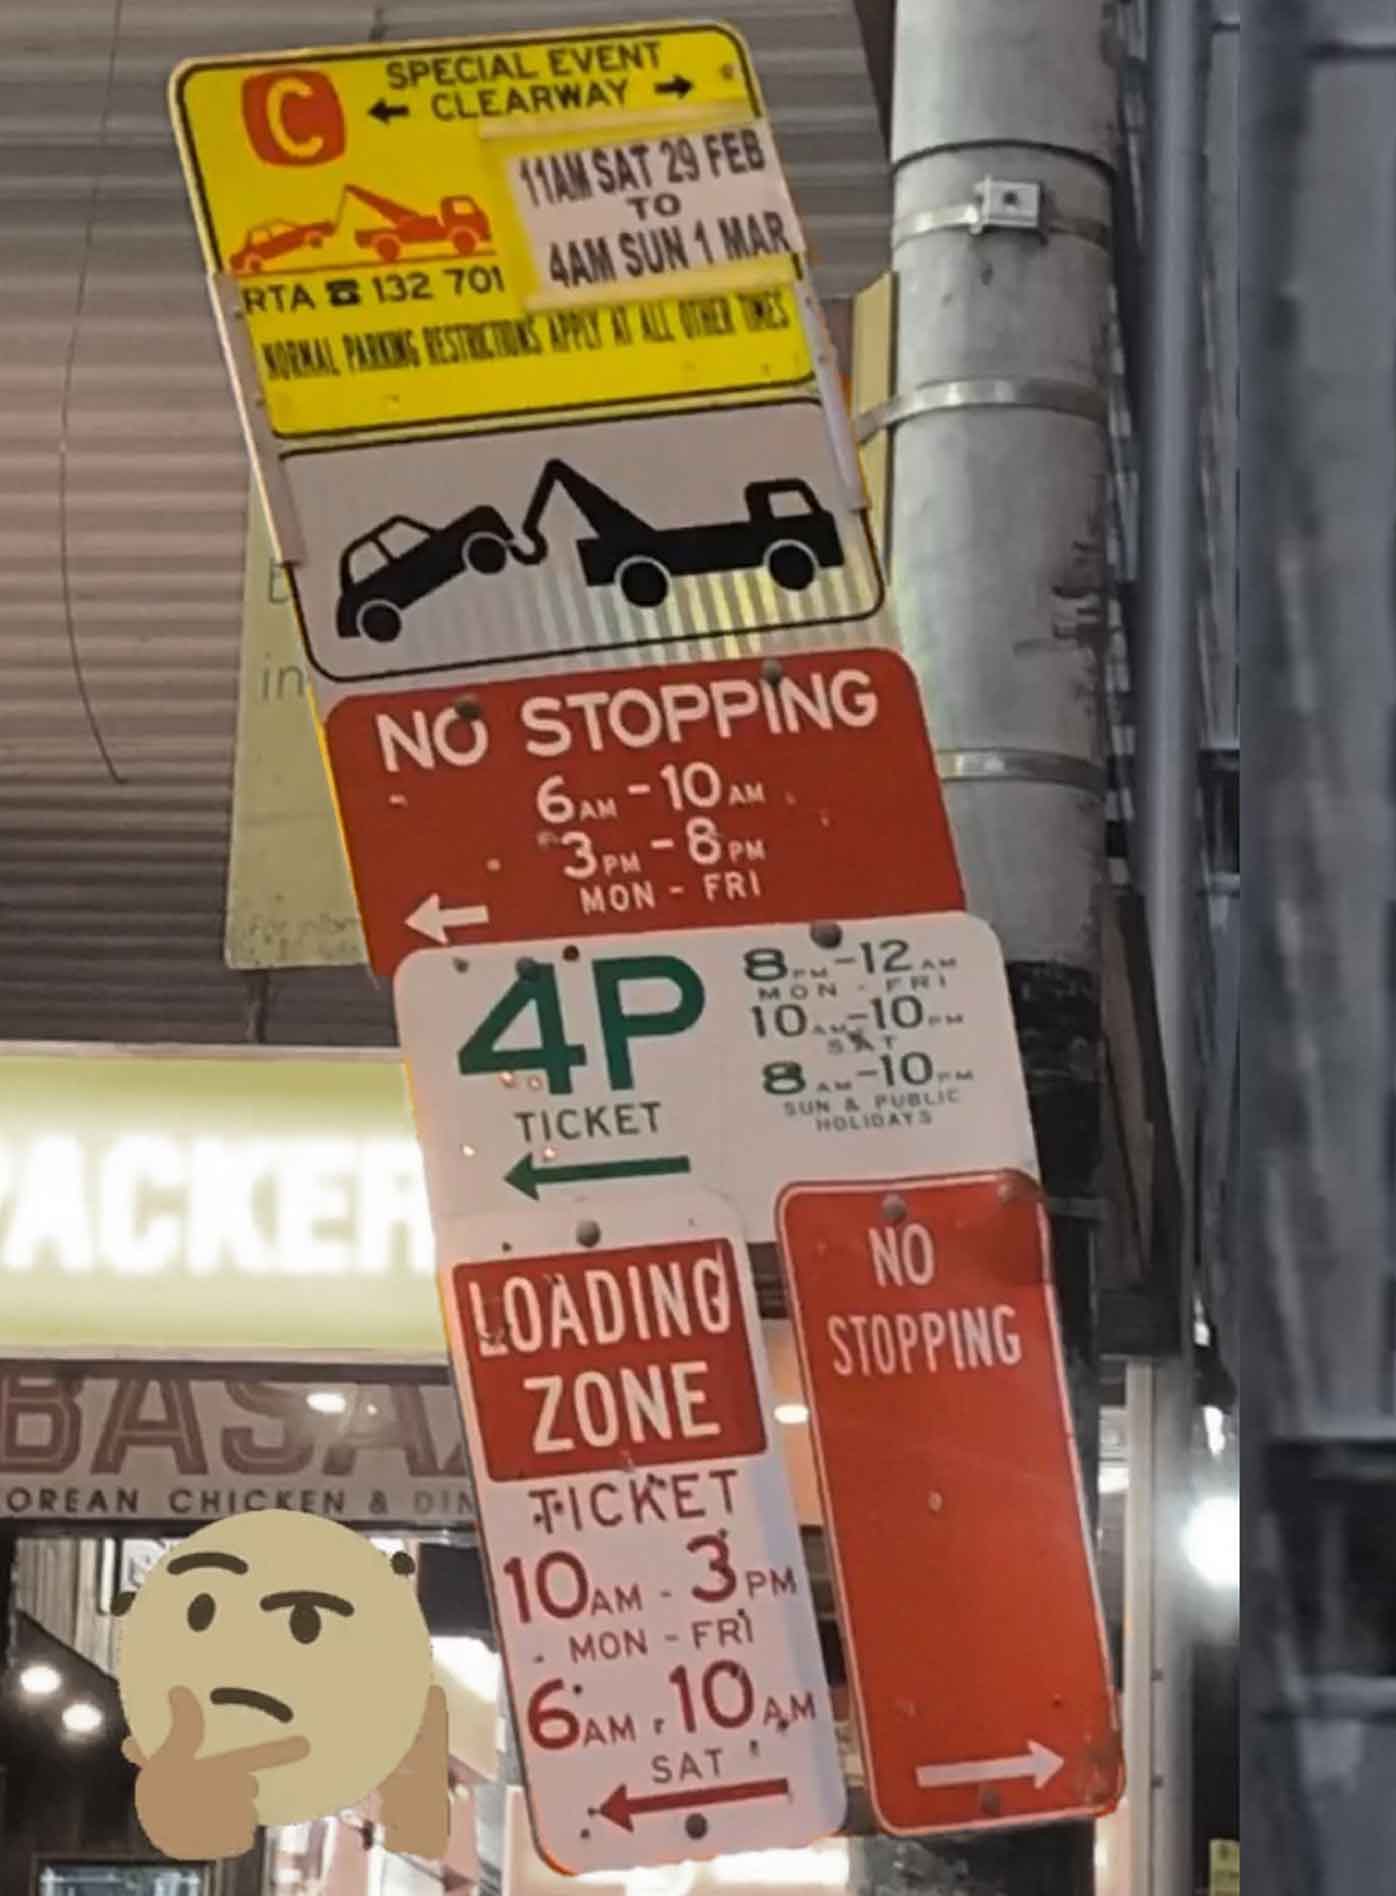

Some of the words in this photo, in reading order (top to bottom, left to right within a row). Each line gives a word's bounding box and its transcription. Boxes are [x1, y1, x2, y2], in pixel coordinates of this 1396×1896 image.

[386, 53, 536, 91] SPECIAL
[548, 41, 662, 78] EVENT
[431, 79, 631, 122] CLEARWAY
[519, 151, 592, 206] 11AM
[591, 144, 652, 193] SAT
[659, 137, 700, 183] 29
[703, 129, 765, 177] FEB
[627, 193, 681, 221] TO
[551, 237, 617, 288] 4AM
[619, 226, 689, 277] SUN
[694, 220, 714, 264] 1
[718, 211, 793, 261] MAR
[242, 284, 316, 315] RTA
[372, 272, 434, 304] 132
[443, 265, 504, 295] 701
[261, 337, 340, 381] NORMAL
[342, 328, 421, 373] PARKING
[423, 316, 541, 366] RESTRICTIONS
[547, 308, 603, 353] APPLY
[610, 304, 632, 347] AT
[639, 299, 675, 342] ALL
[678, 295, 735, 339] OTHER
[736, 289, 790, 332] TIMES
[376, 700, 488, 773] NO
[521, 669, 879, 757] STOPPING
[579, 881, 656, 915] MON
[703, 869, 761, 901] FRI
[757, 983, 838, 1000] MON
[886, 976, 947, 991] FRI
[458, 952, 706, 1095] 4P
[514, 1101, 662, 1143] TICKET
[784, 1099, 830, 1117] SUN
[844, 1097, 860, 1113] &
[875, 1089, 961, 1110] PUBLIC
[816, 1109, 932, 1133] HOLIDAYS
[0, 1132, 436, 1276] ACKER
[868, 1221, 935, 1288] NO
[466, 1255, 732, 1357] LOADING
[827, 1304, 1022, 1377] STOPPING
[0, 1378, 466, 1476] BASA
[523, 1362, 722, 1454] ZONE
[170, 1488, 344, 1514] CHICKEN
[368, 1489, 388, 1515] &
[528, 1468, 738, 1535] TICKET
[569, 1628, 649, 1664] MON
[691, 1613, 754, 1649] FRI
[650, 1748, 723, 1784] SAT
